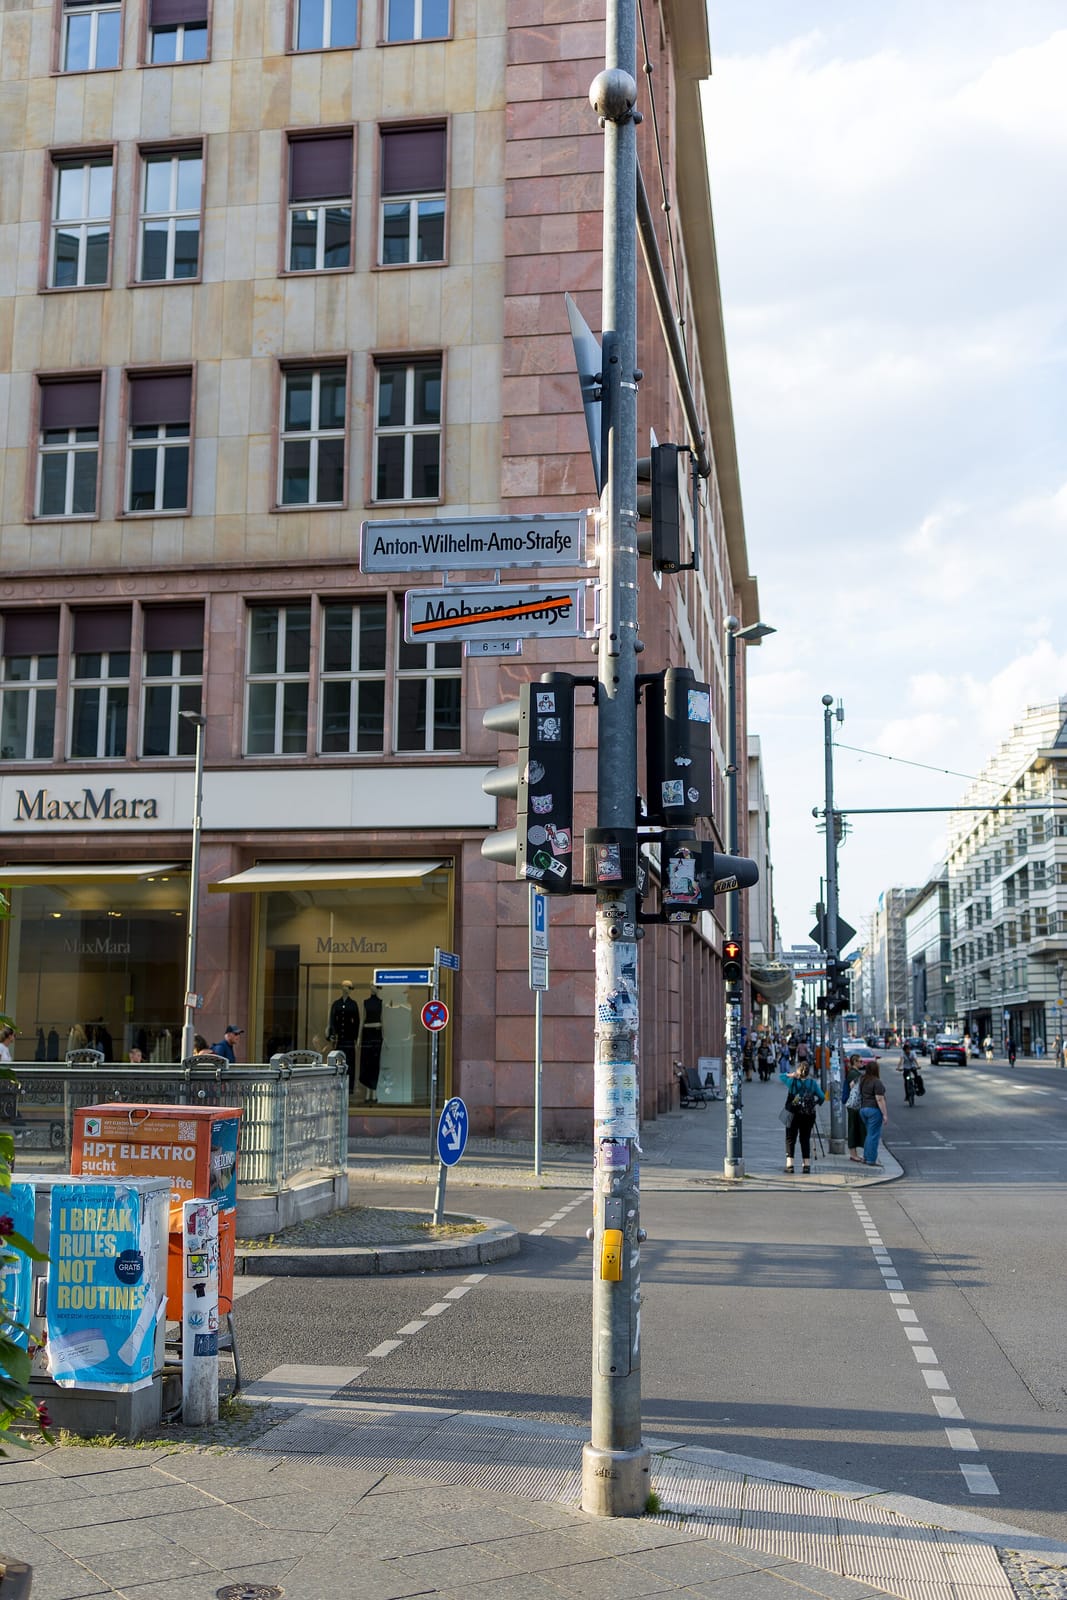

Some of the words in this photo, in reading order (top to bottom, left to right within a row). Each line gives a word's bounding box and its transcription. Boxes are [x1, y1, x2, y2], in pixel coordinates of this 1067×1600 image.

[373, 529, 572, 555] Anton-Wilhelm-Amo-Straße
[482, 642, 489, 651] 6
[500, 642, 510, 651] 14
[13, 788, 158, 821] MaxMara
[536, 899, 543, 927] P
[63, 936, 131, 953] MaxMara
[316, 936, 388, 953] MaxMara
[82, 1142, 117, 1158] HPT
[119, 1144, 196, 1162] ELEKTRO
[82, 1160, 117, 1171] sucht
[59, 1208, 65, 1231] I
[70, 1208, 132, 1232] BREAK
[59, 1233, 121, 1258] RULES.
[58, 1260, 96, 1283] NOT
[57, 1285, 145, 1310] ROUTINES
